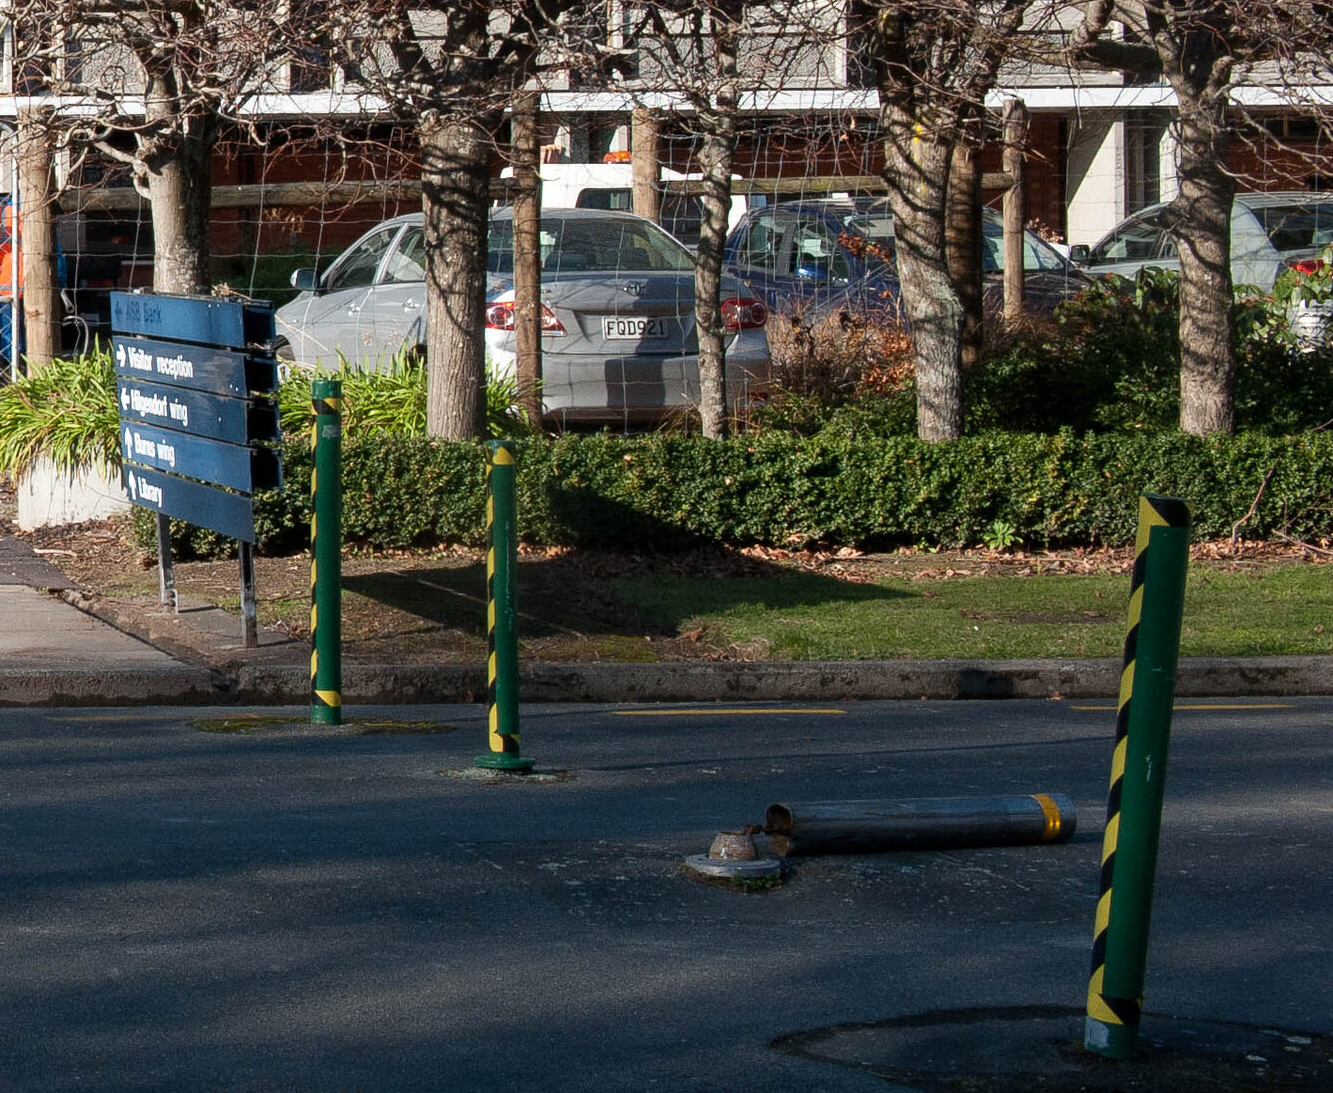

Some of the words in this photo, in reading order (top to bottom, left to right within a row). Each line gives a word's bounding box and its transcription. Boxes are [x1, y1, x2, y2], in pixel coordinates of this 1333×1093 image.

[606, 320, 665, 336] FQD921
[127, 346, 153, 372] Visitor
[156, 354, 194, 380] reception
[169, 397, 188, 427] wing
[157, 438, 176, 468] wing
[137, 476, 163, 509] Library
